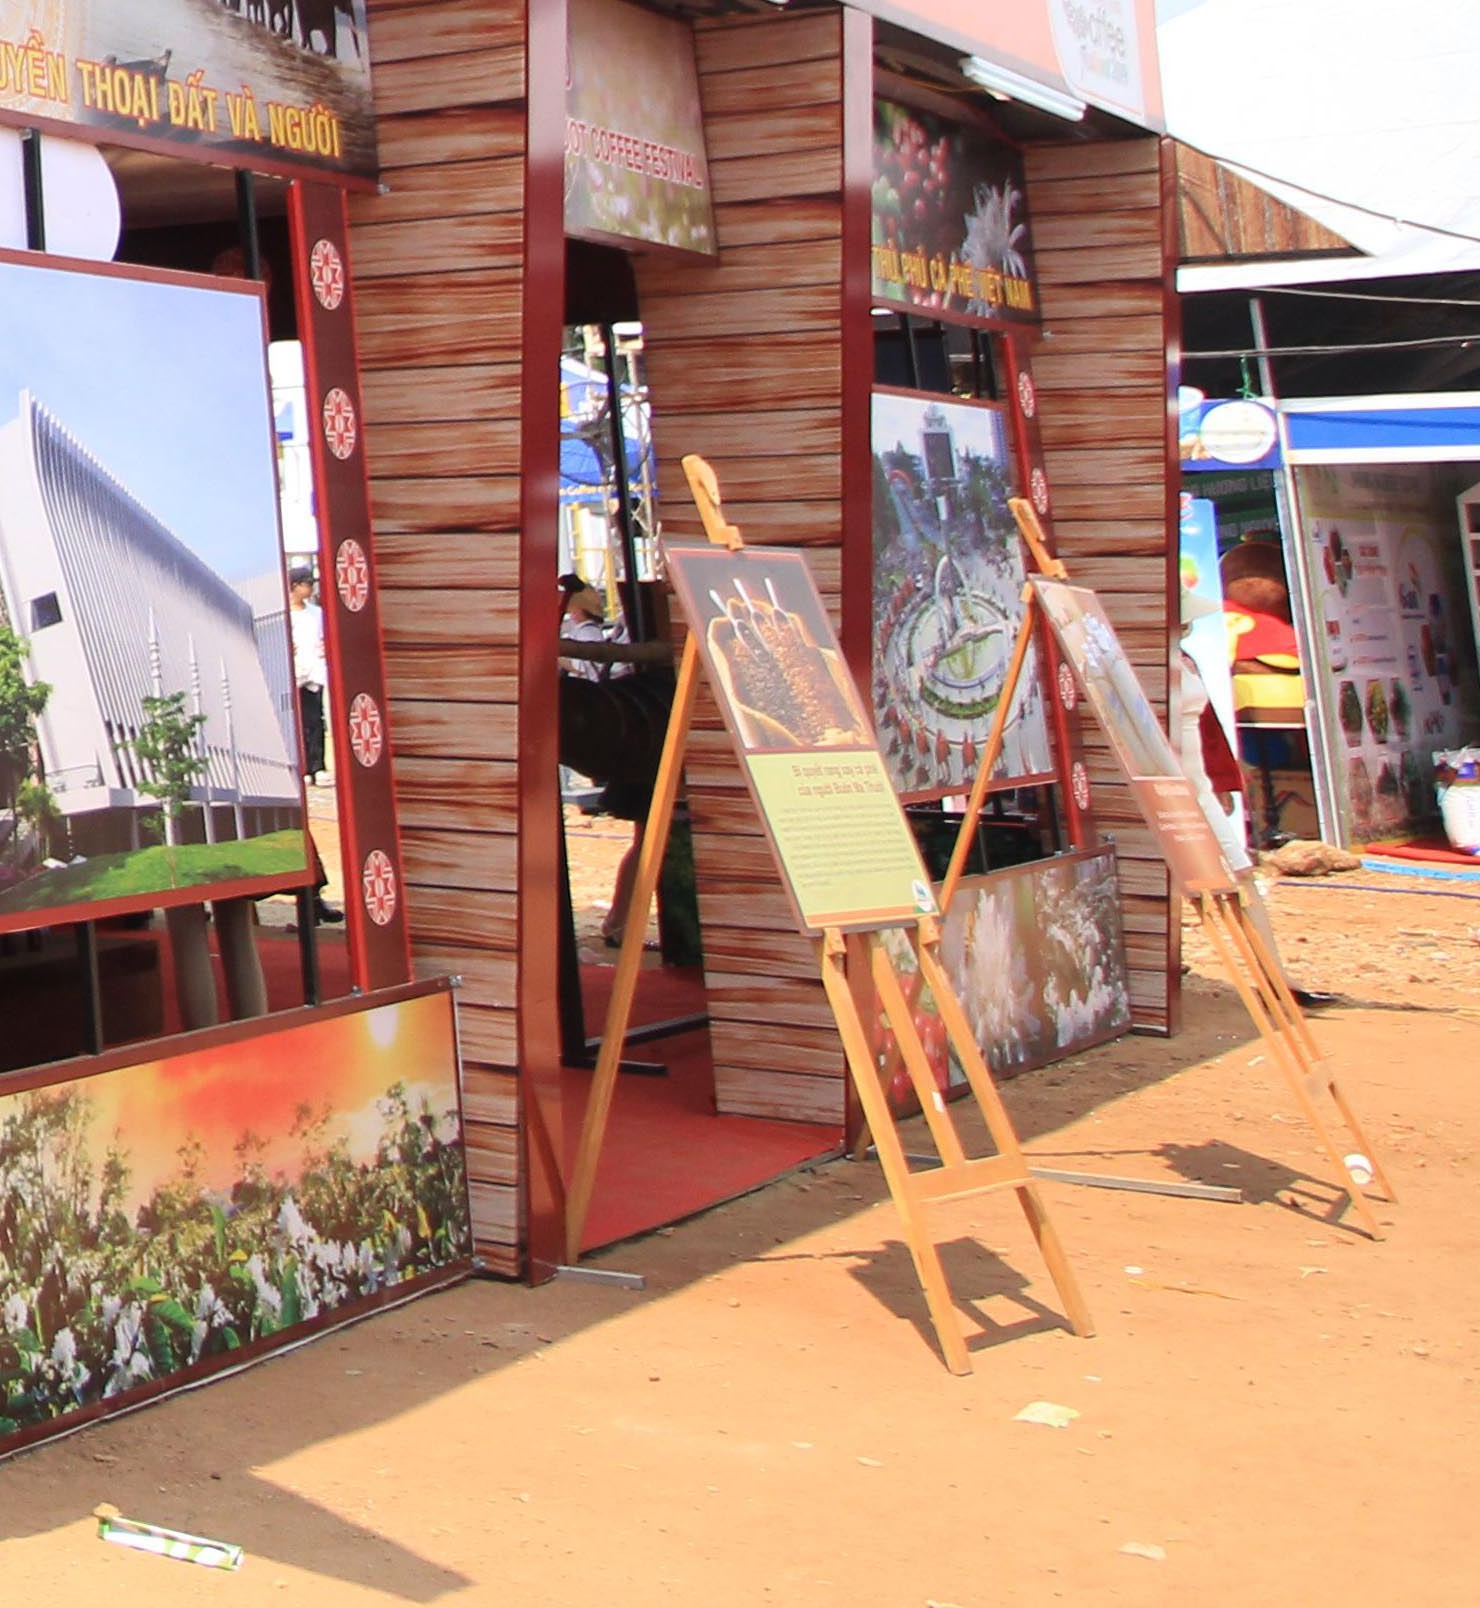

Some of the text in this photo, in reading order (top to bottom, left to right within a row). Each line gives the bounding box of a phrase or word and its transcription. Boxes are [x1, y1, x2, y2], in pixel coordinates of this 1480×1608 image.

[77, 59, 160, 131] THOẠI
[168, 66, 218, 135] ĐẤT
[224, 84, 262, 143] VÀ
[268, 102, 341, 159] NGƯỜI
[590, 126, 643, 174] COFFEE
[642, 139, 703, 189] FESTIVAL
